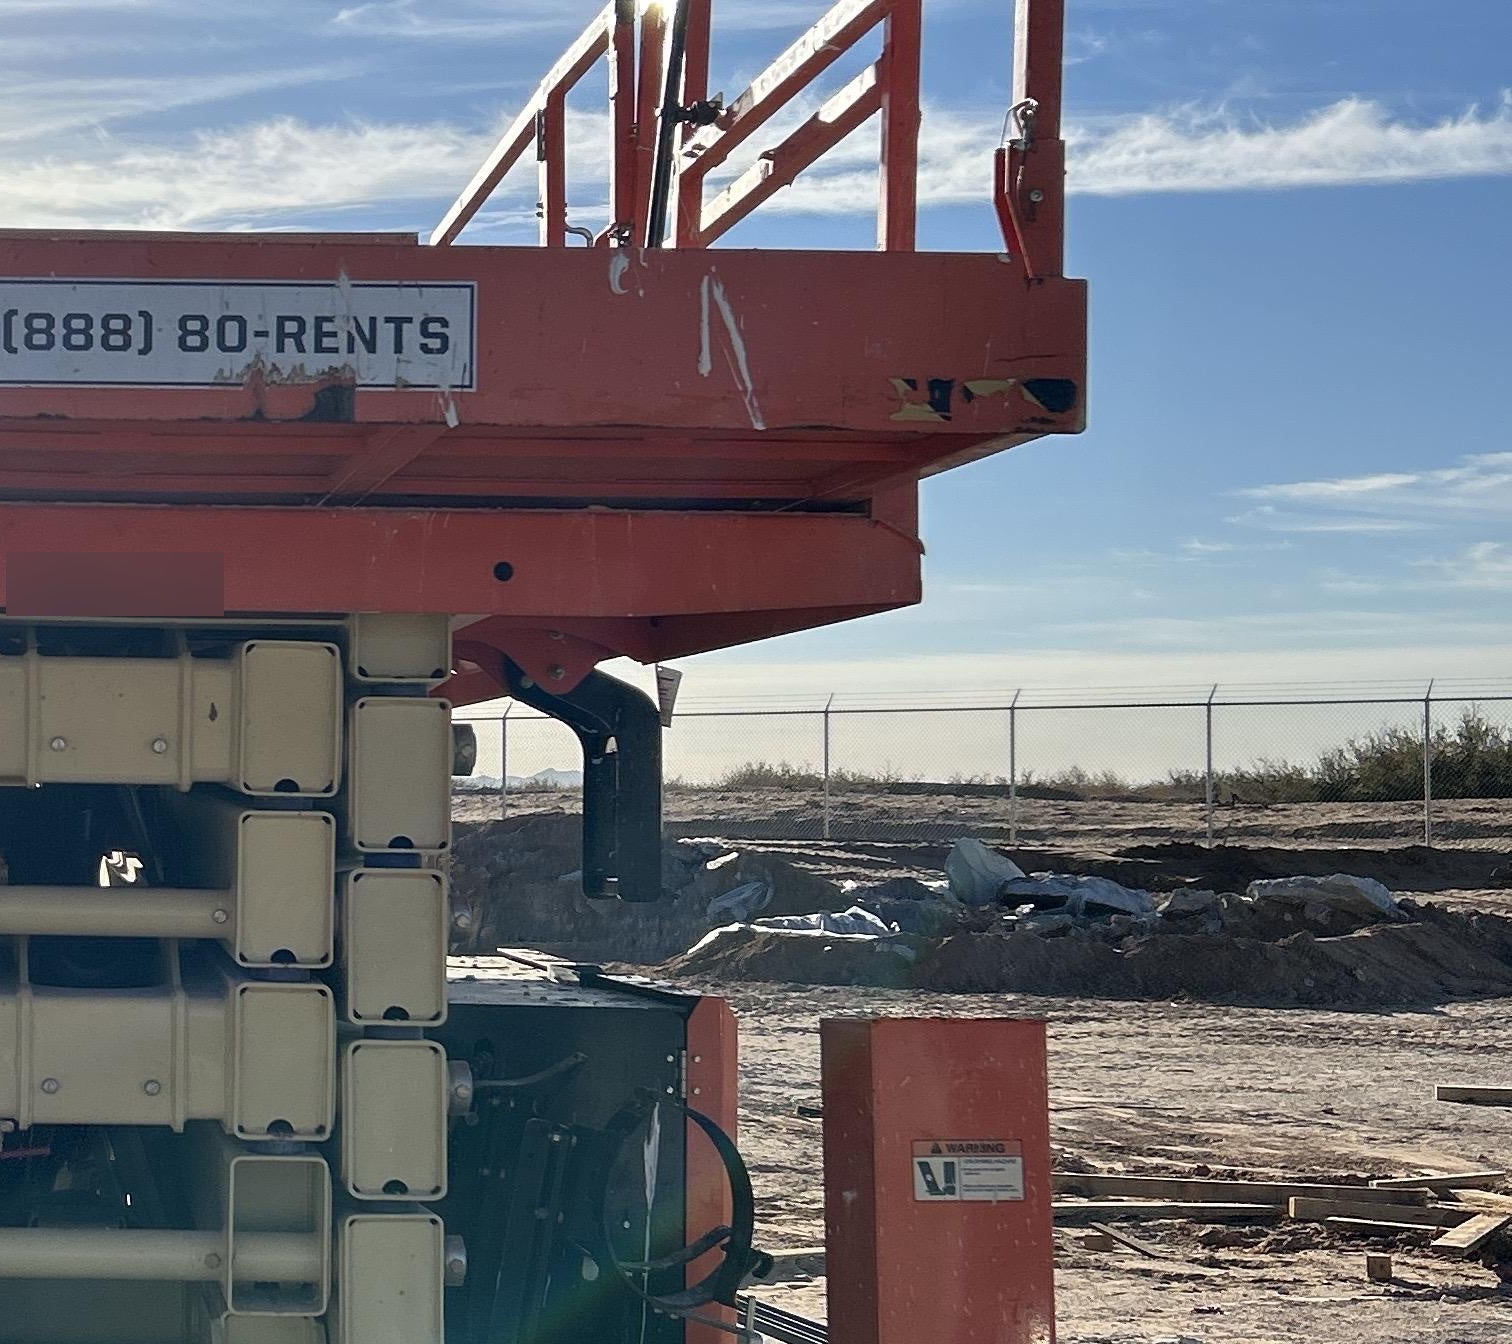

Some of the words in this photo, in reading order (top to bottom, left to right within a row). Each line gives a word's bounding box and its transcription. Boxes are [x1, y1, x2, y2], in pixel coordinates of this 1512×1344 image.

[2, 308, 154, 356] (888)
[176, 313, 451, 356] 80-RENTS
[945, 1143, 1006, 1154] WARNING
